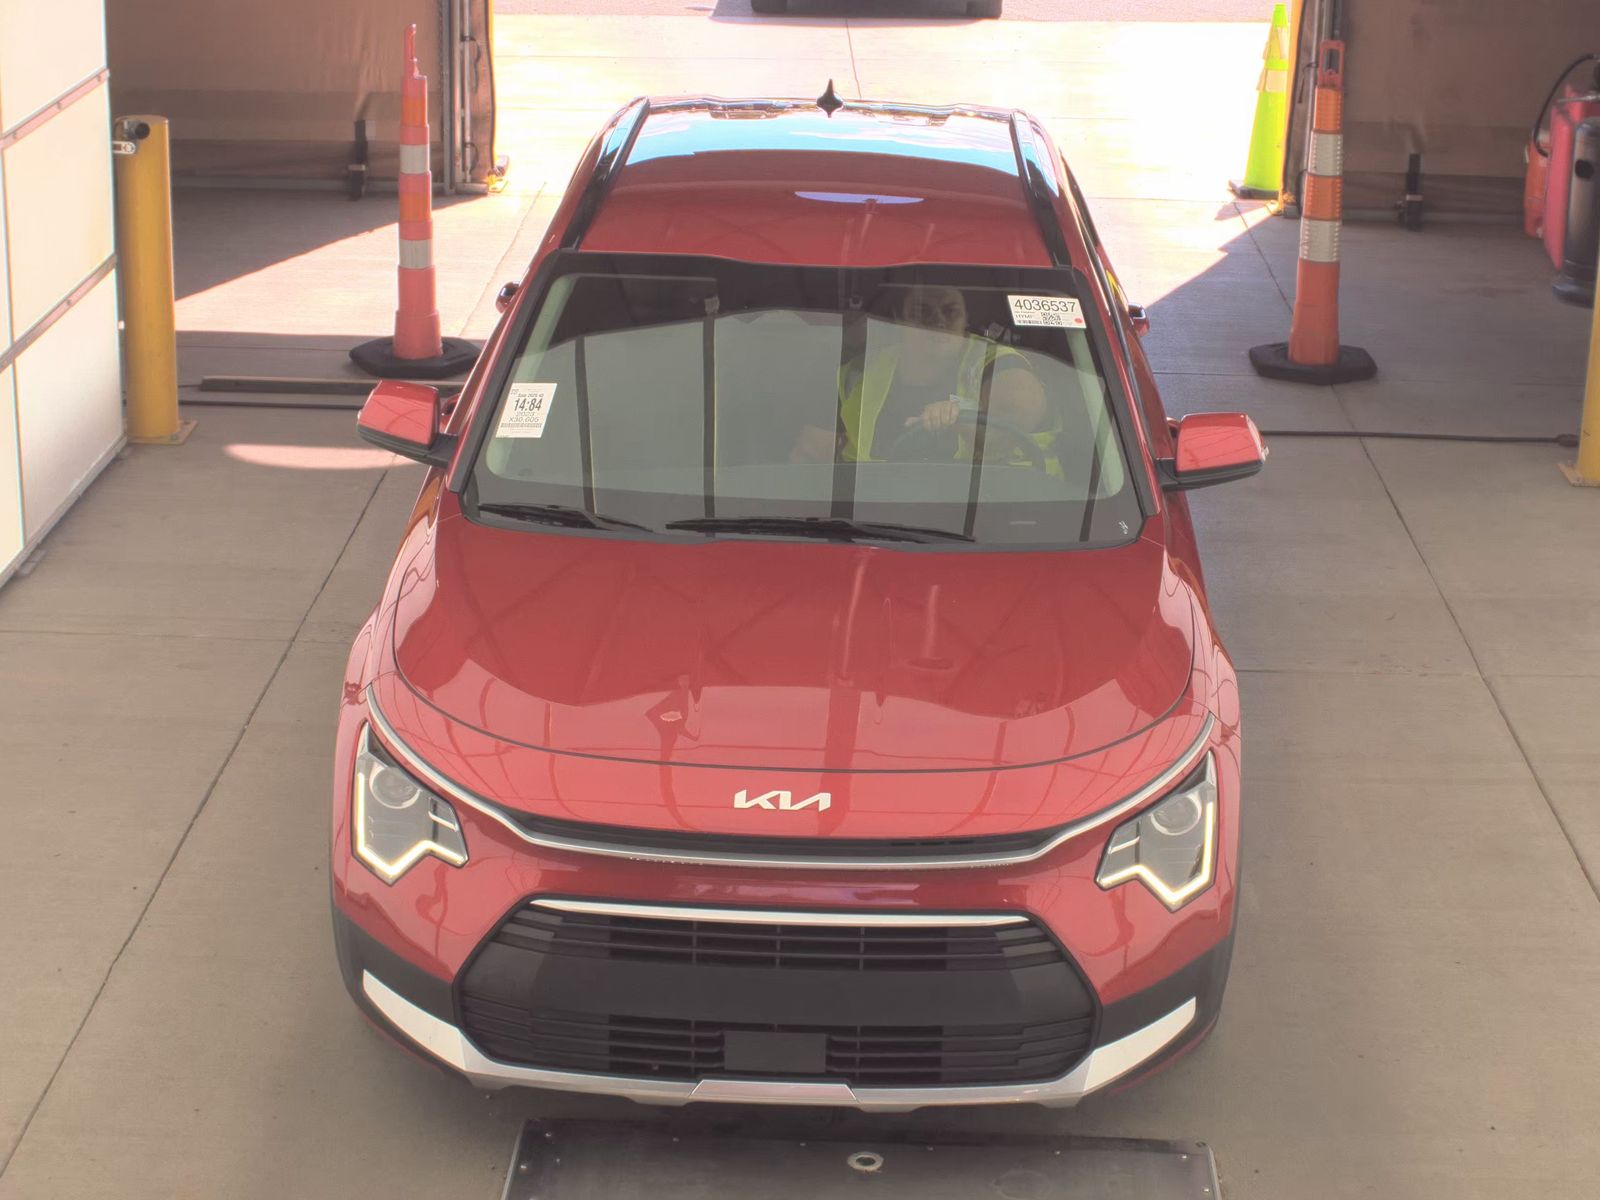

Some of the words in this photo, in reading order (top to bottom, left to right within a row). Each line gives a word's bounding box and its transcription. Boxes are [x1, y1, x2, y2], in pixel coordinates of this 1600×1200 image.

[1014, 299, 1076, 312] 4036537
[514, 398, 543, 411] 14:84
[734, 789, 832, 812] KIA
